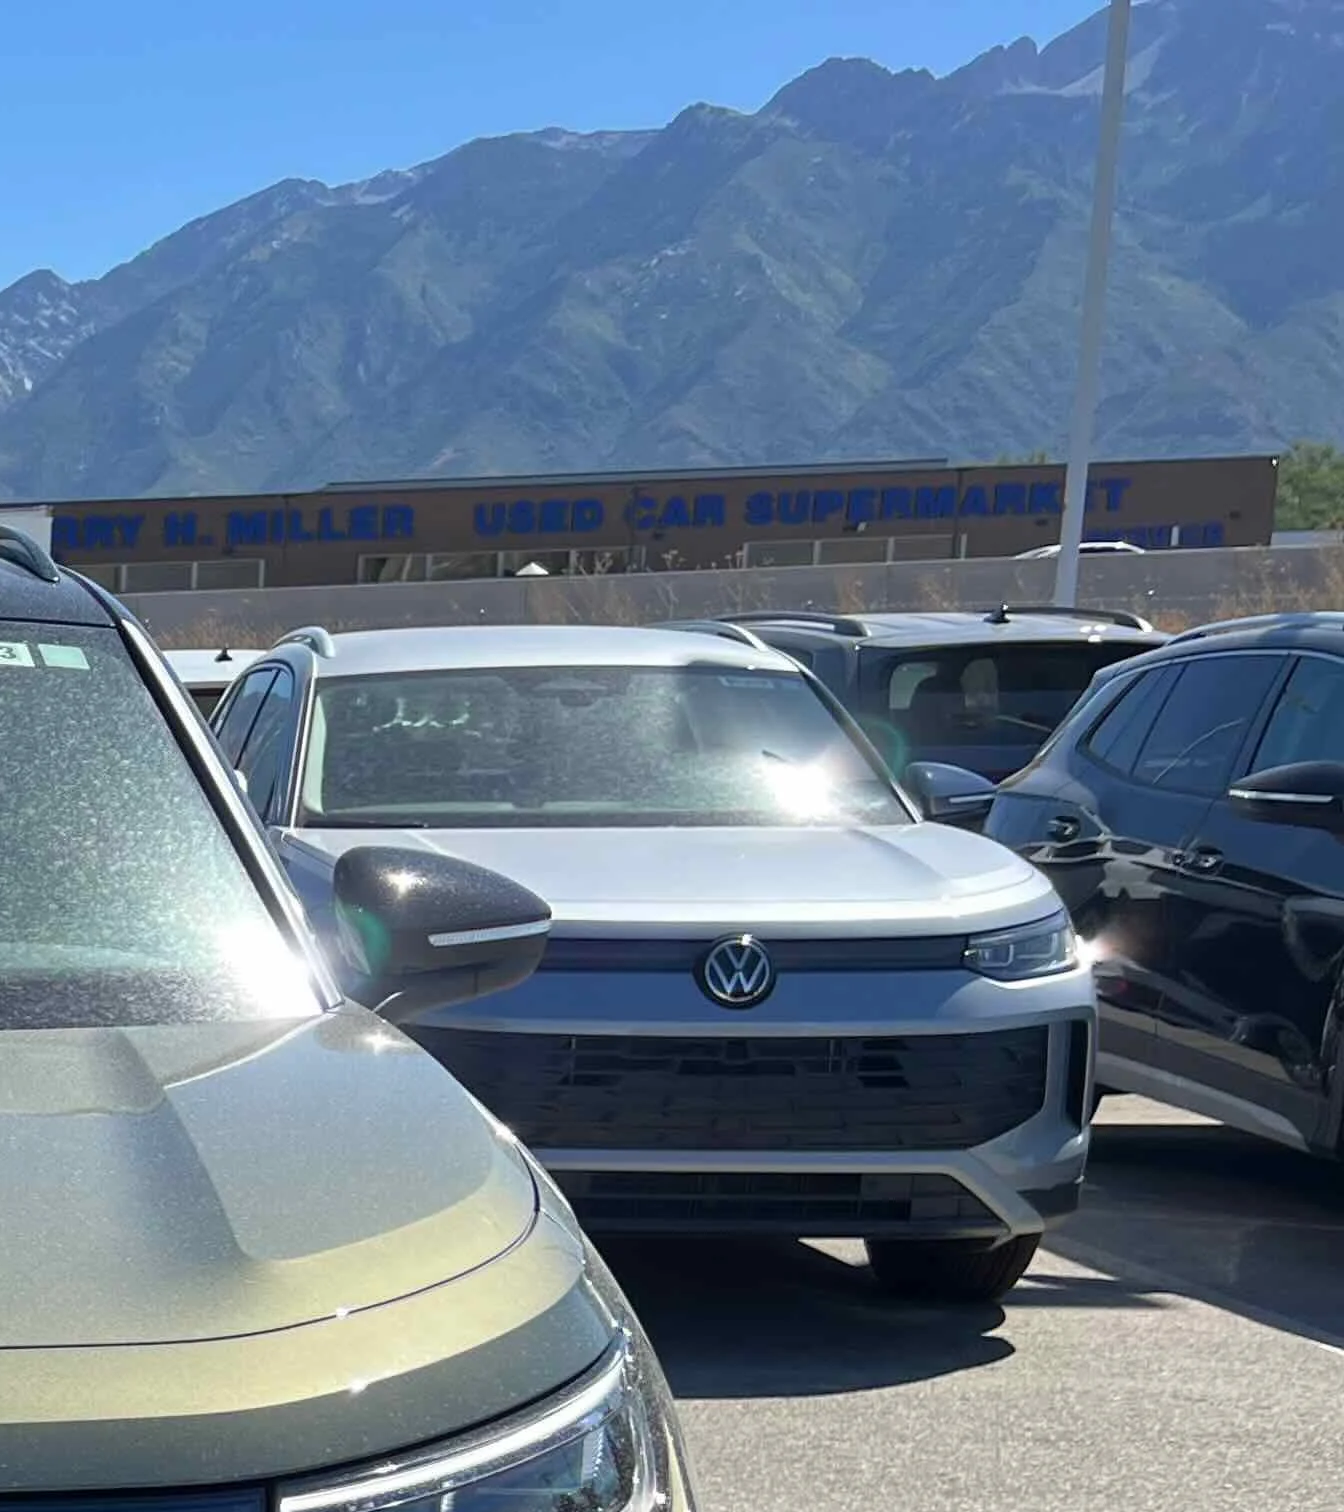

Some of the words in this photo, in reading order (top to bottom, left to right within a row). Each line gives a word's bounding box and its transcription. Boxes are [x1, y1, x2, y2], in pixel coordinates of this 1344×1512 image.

[164, 510, 213, 546] H.
[226, 504, 416, 546] MILLER
[473, 498, 605, 536] USED
[624, 494, 726, 529] CAR
